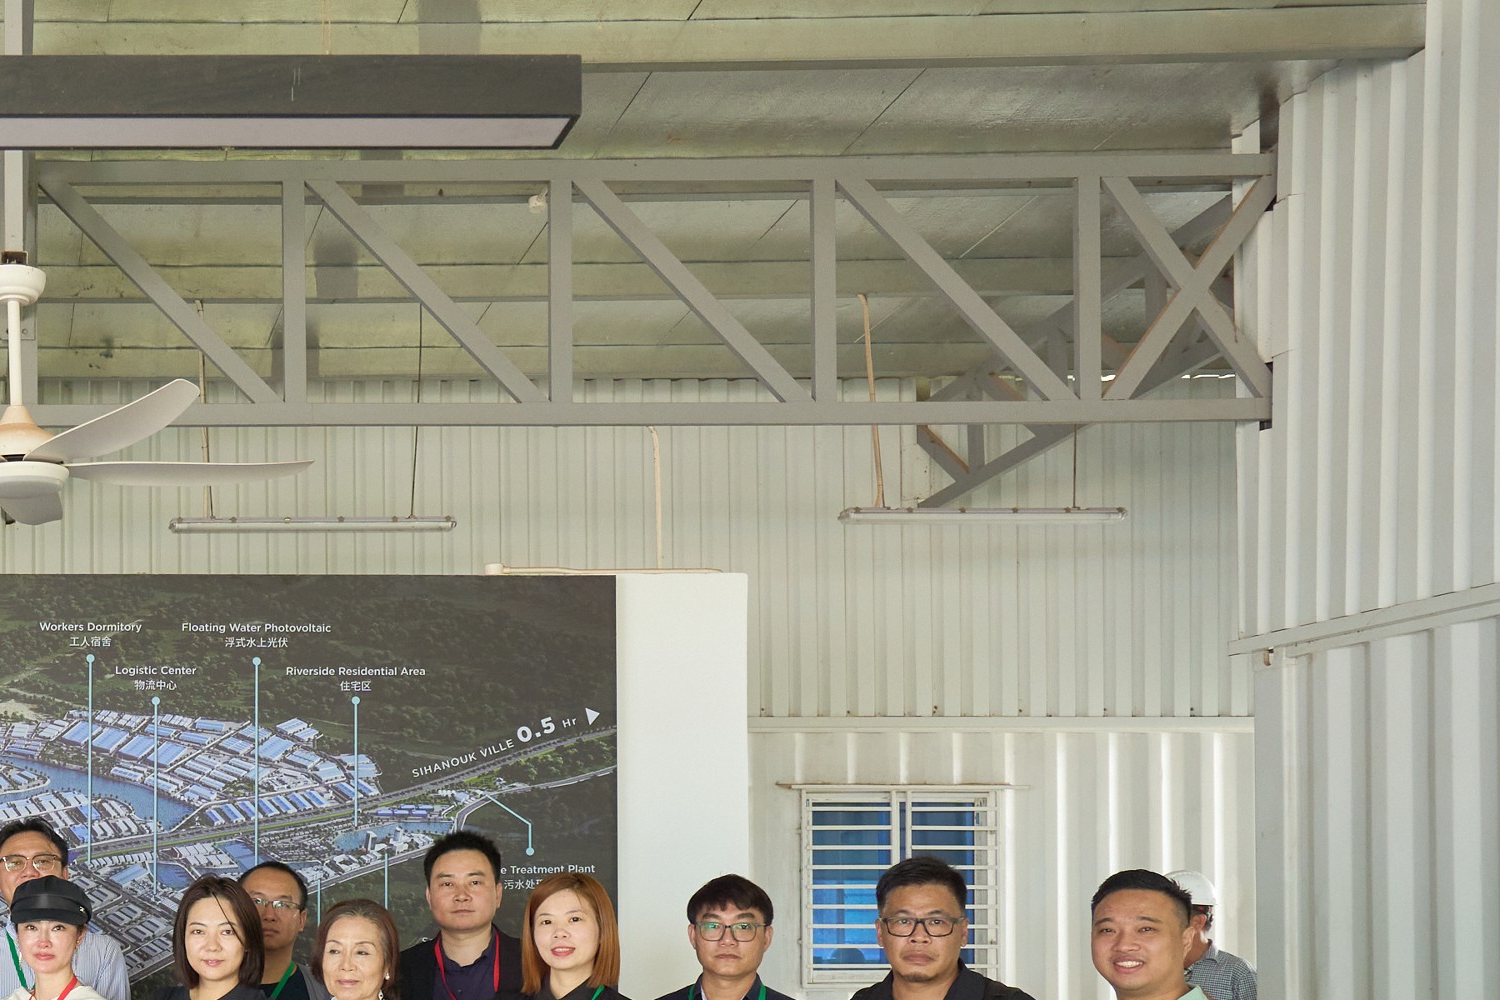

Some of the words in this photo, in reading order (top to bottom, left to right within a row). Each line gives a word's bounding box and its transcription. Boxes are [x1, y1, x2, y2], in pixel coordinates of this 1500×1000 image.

[39, 622, 84, 632] Workers
[87, 622, 142, 633] Dormitory
[181, 622, 227, 634] Floating
[229, 623, 262, 633] Water
[264, 623, 332, 633] Photovoltaic
[69, 636, 112, 647] 工人宿舍
[225, 637, 288, 648] 浮式水上光伏
[115, 666, 158, 676] Logistic
[160, 666, 197, 675] Center
[286, 667, 336, 676] Riverside
[338, 667, 398, 676] Residential
[400, 667, 426, 676] Area
[134, 680, 177, 691] 物流中心
[340, 681, 372, 692] 住宅区
[412, 752, 477, 778] SIHANOUK
[479, 739, 515, 758] VILLE
[516, 716, 556, 743] 0.5
[562, 717, 577, 728] Hr
[510, 865, 564, 874] Treatment
[568, 865, 595, 873] Plant
[504, 879, 543, 889] 污水处
